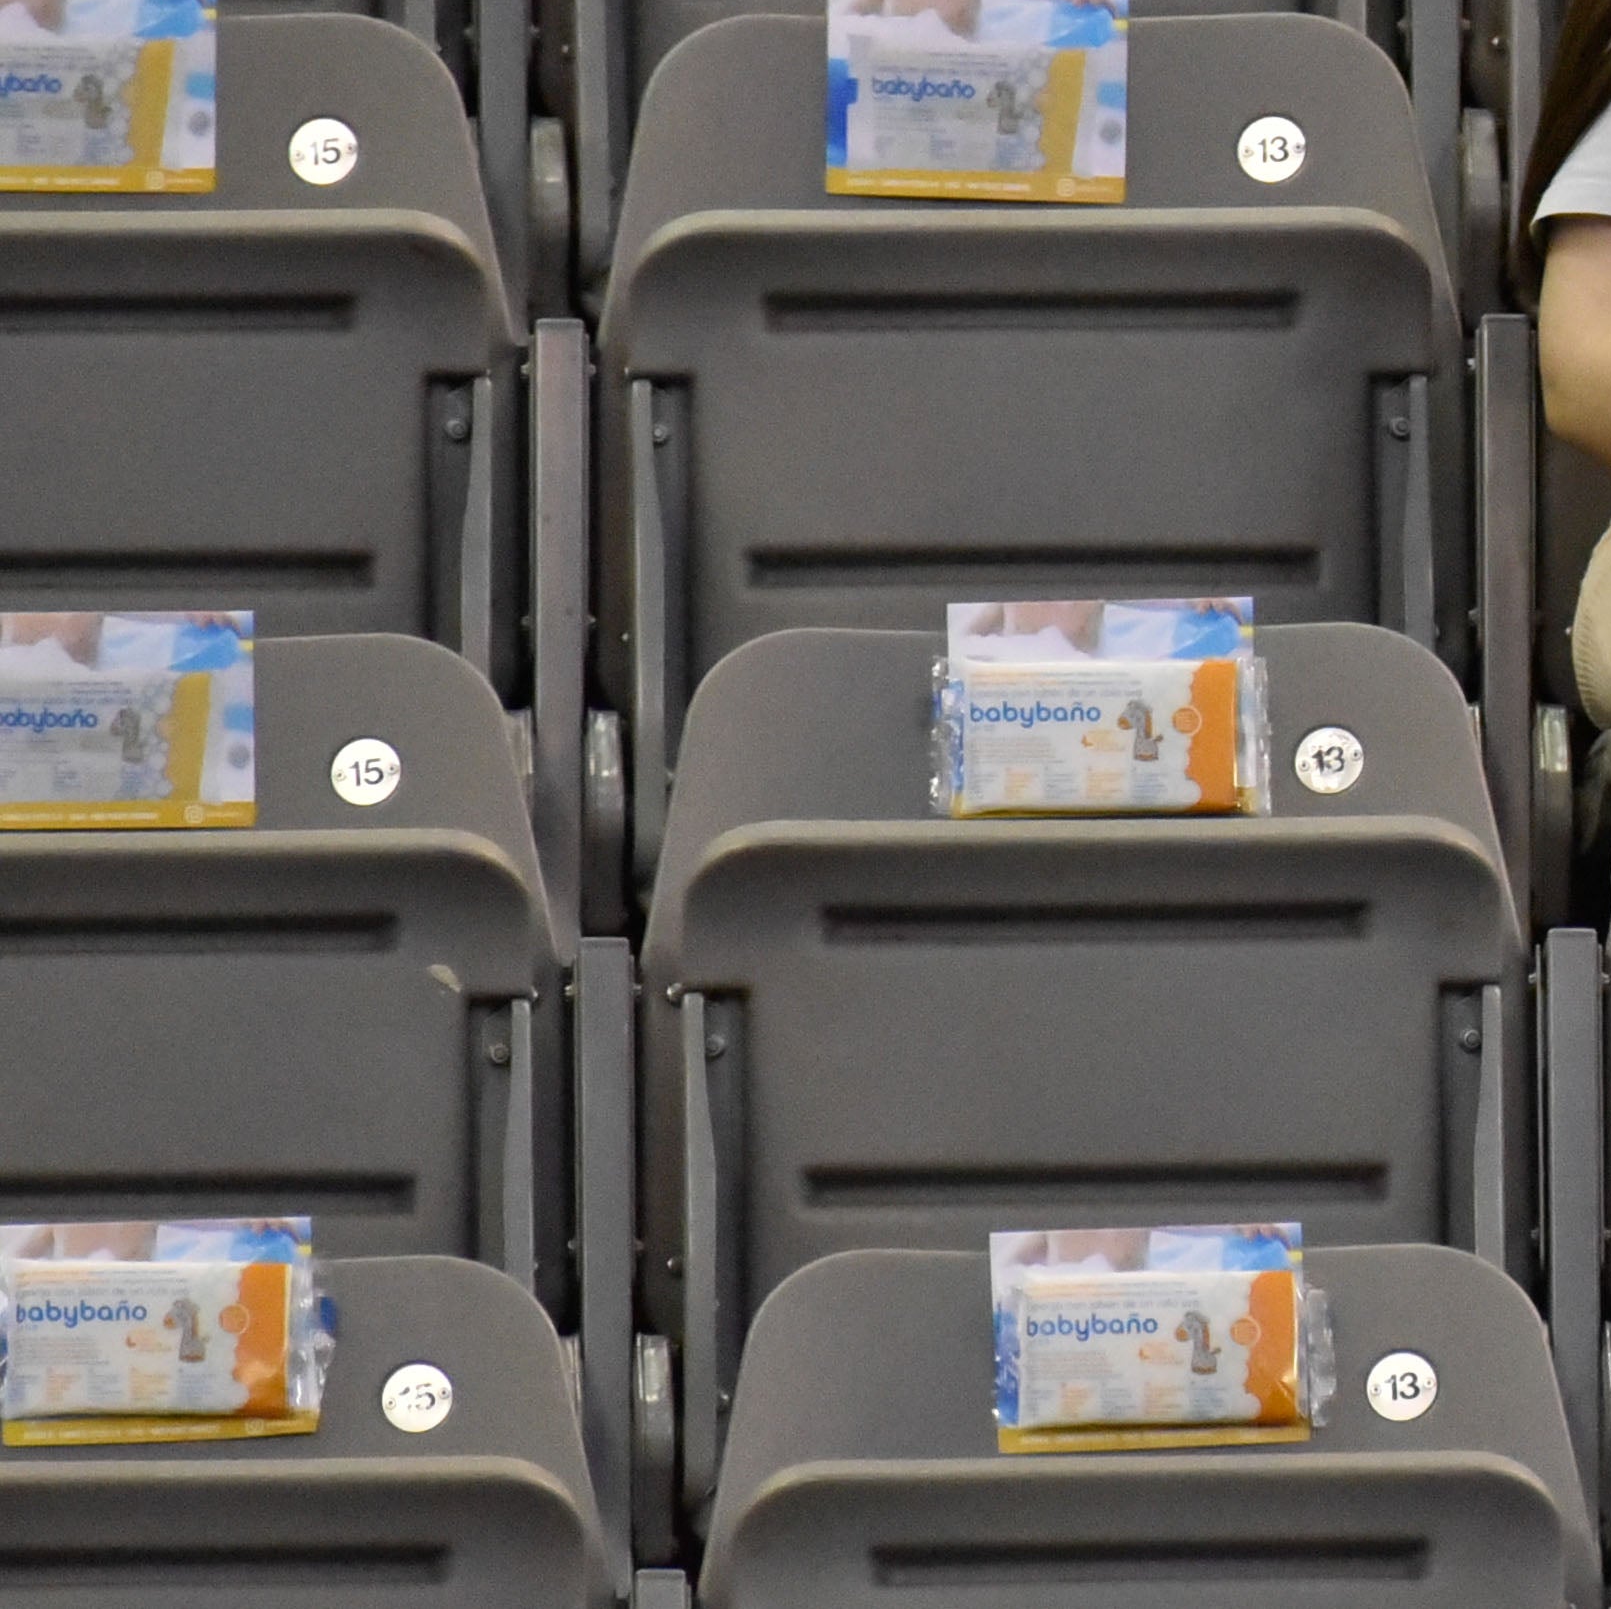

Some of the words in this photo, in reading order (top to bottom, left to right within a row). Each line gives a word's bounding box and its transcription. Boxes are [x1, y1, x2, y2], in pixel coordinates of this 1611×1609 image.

[872, 76, 975, 101] babybaño
[309, 137, 341, 166] 15
[1257, 136, 1290, 163] 13
[970, 701, 1102, 728] babybaño
[351, 757, 384, 787] 15
[1311, 745, 1345, 775] 13
[16, 1299, 147, 1328] babybaño
[1027, 1313, 1158, 1341] babybaño
[1385, 1372, 1420, 1401] 13
